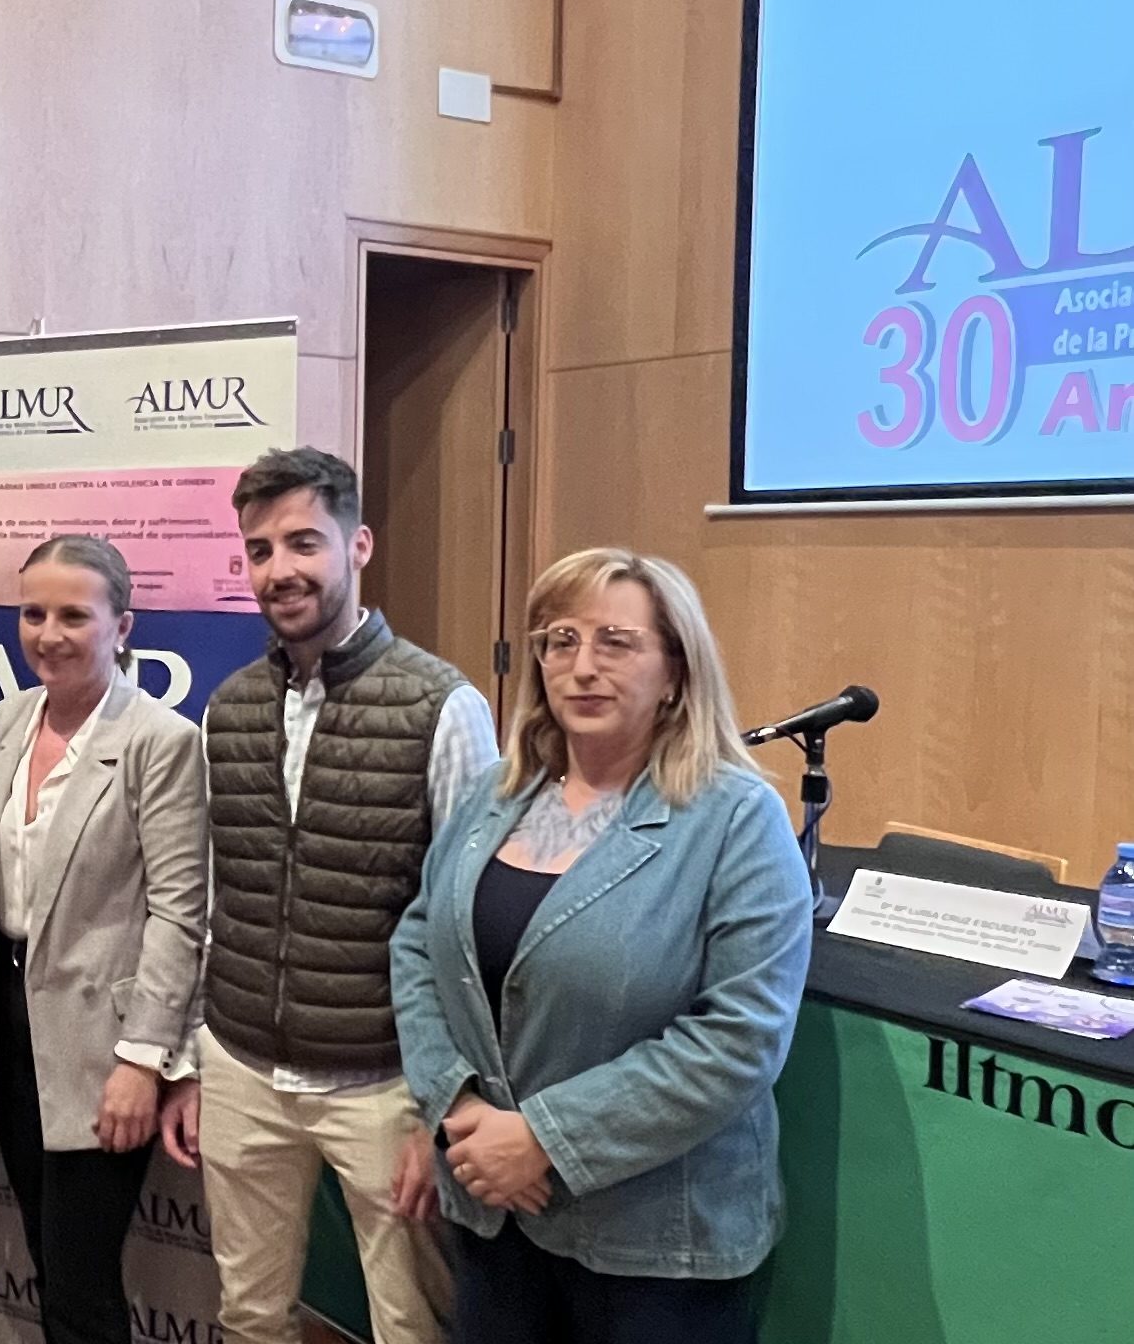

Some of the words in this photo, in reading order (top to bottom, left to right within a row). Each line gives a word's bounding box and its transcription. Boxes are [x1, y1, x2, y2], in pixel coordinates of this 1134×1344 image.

[1053, 329, 1083, 356] de
[1086, 326, 1108, 353] la
[857, 294, 1023, 450] 30
[125, 376, 270, 426] ALMUR
